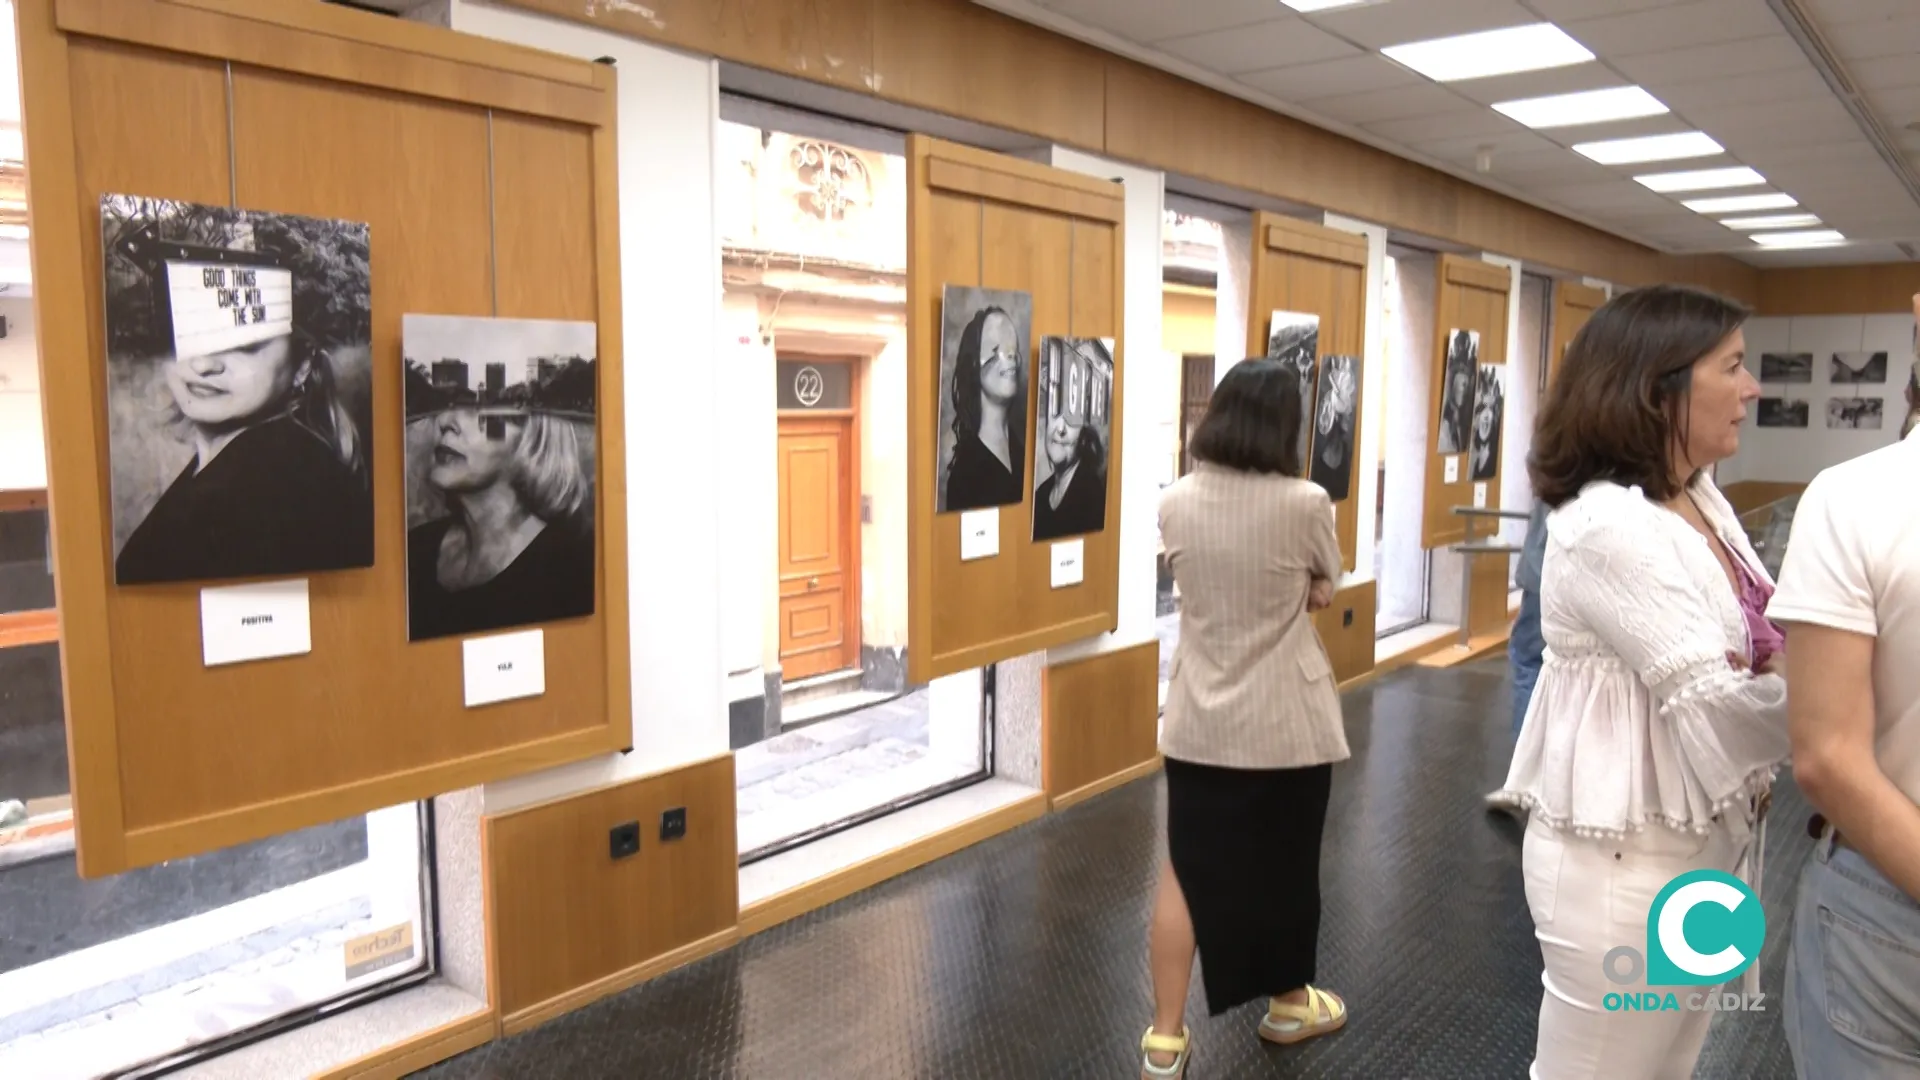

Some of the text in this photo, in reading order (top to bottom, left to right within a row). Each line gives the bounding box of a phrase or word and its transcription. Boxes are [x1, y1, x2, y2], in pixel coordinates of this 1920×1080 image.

[203, 267, 256, 289] GOOD THINGS
[217, 287, 261, 309] COME WITH
[232, 303, 266, 326] THE SUN
[800, 374, 819, 398] 22
[241, 613, 273, 627] POSITIVA
